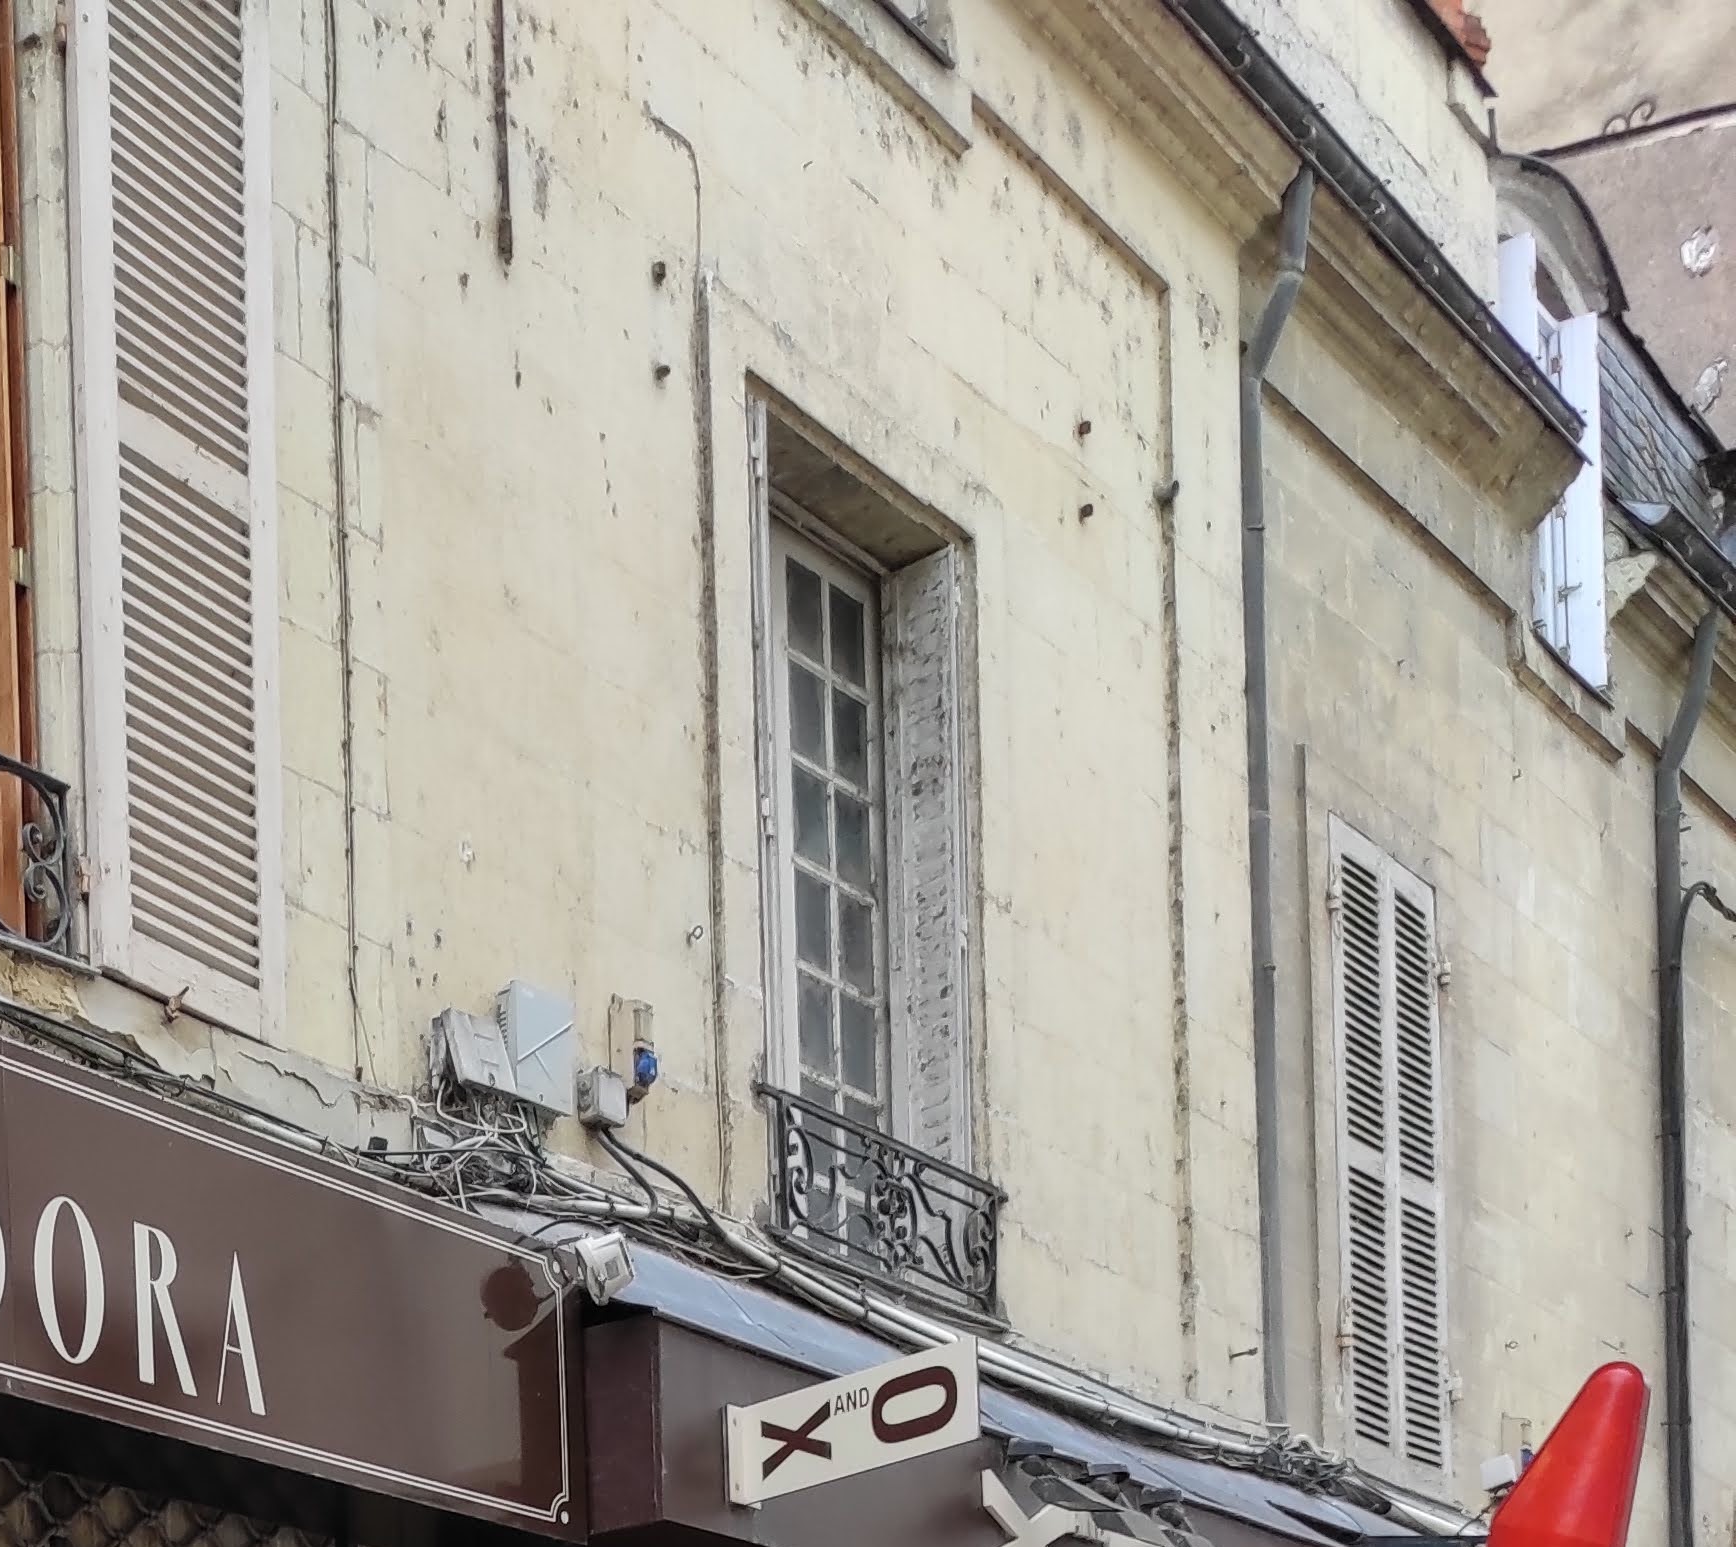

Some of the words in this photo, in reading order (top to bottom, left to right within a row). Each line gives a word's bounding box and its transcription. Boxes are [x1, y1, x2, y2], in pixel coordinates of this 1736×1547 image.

[761, 1400, 832, 1482] X
[834, 1387, 870, 1416] AND
[872, 1365, 958, 1444] O
